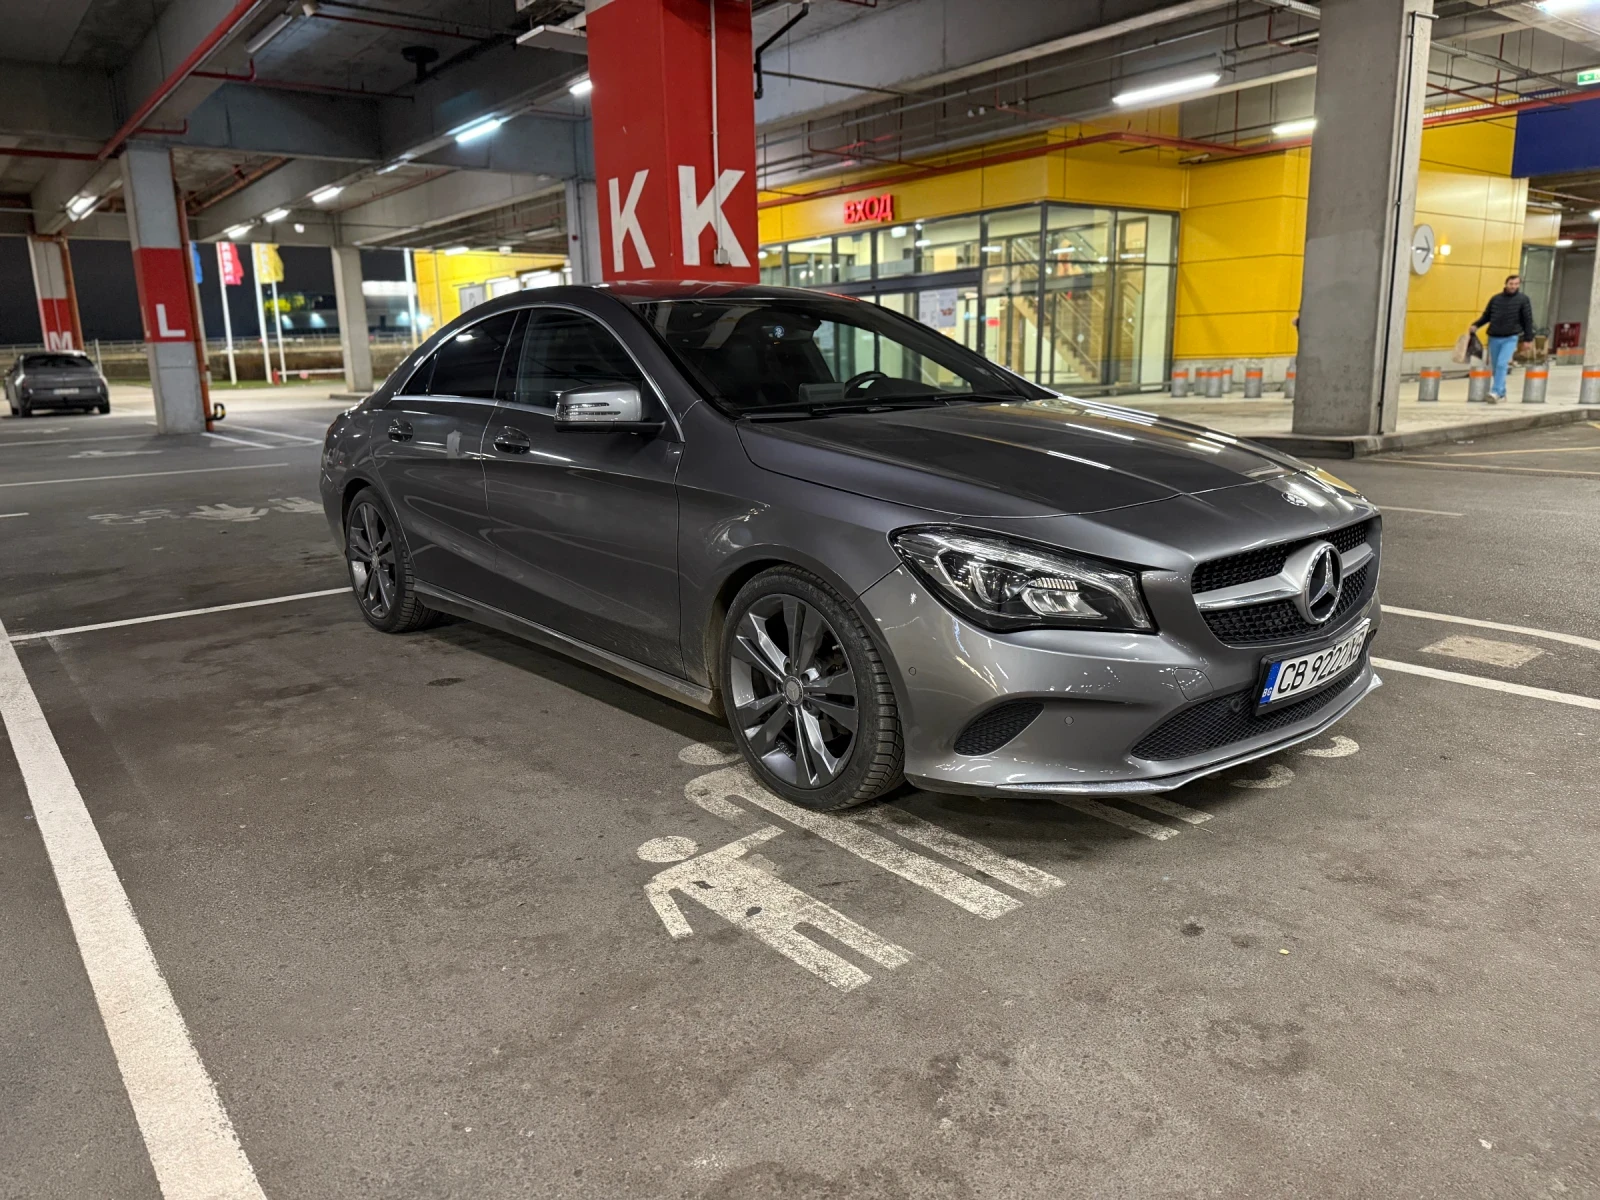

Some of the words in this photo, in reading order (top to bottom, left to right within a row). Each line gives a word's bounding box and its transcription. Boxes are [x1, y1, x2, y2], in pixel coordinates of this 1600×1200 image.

[608, 169, 656, 273] K
[678, 165, 751, 267] K
[844, 193, 893, 224] ВХОД
[156, 303, 186, 337] L
[49, 331, 73, 351] M
[1261, 687, 1274, 698] BG
[1277, 660, 1309, 694] CB
